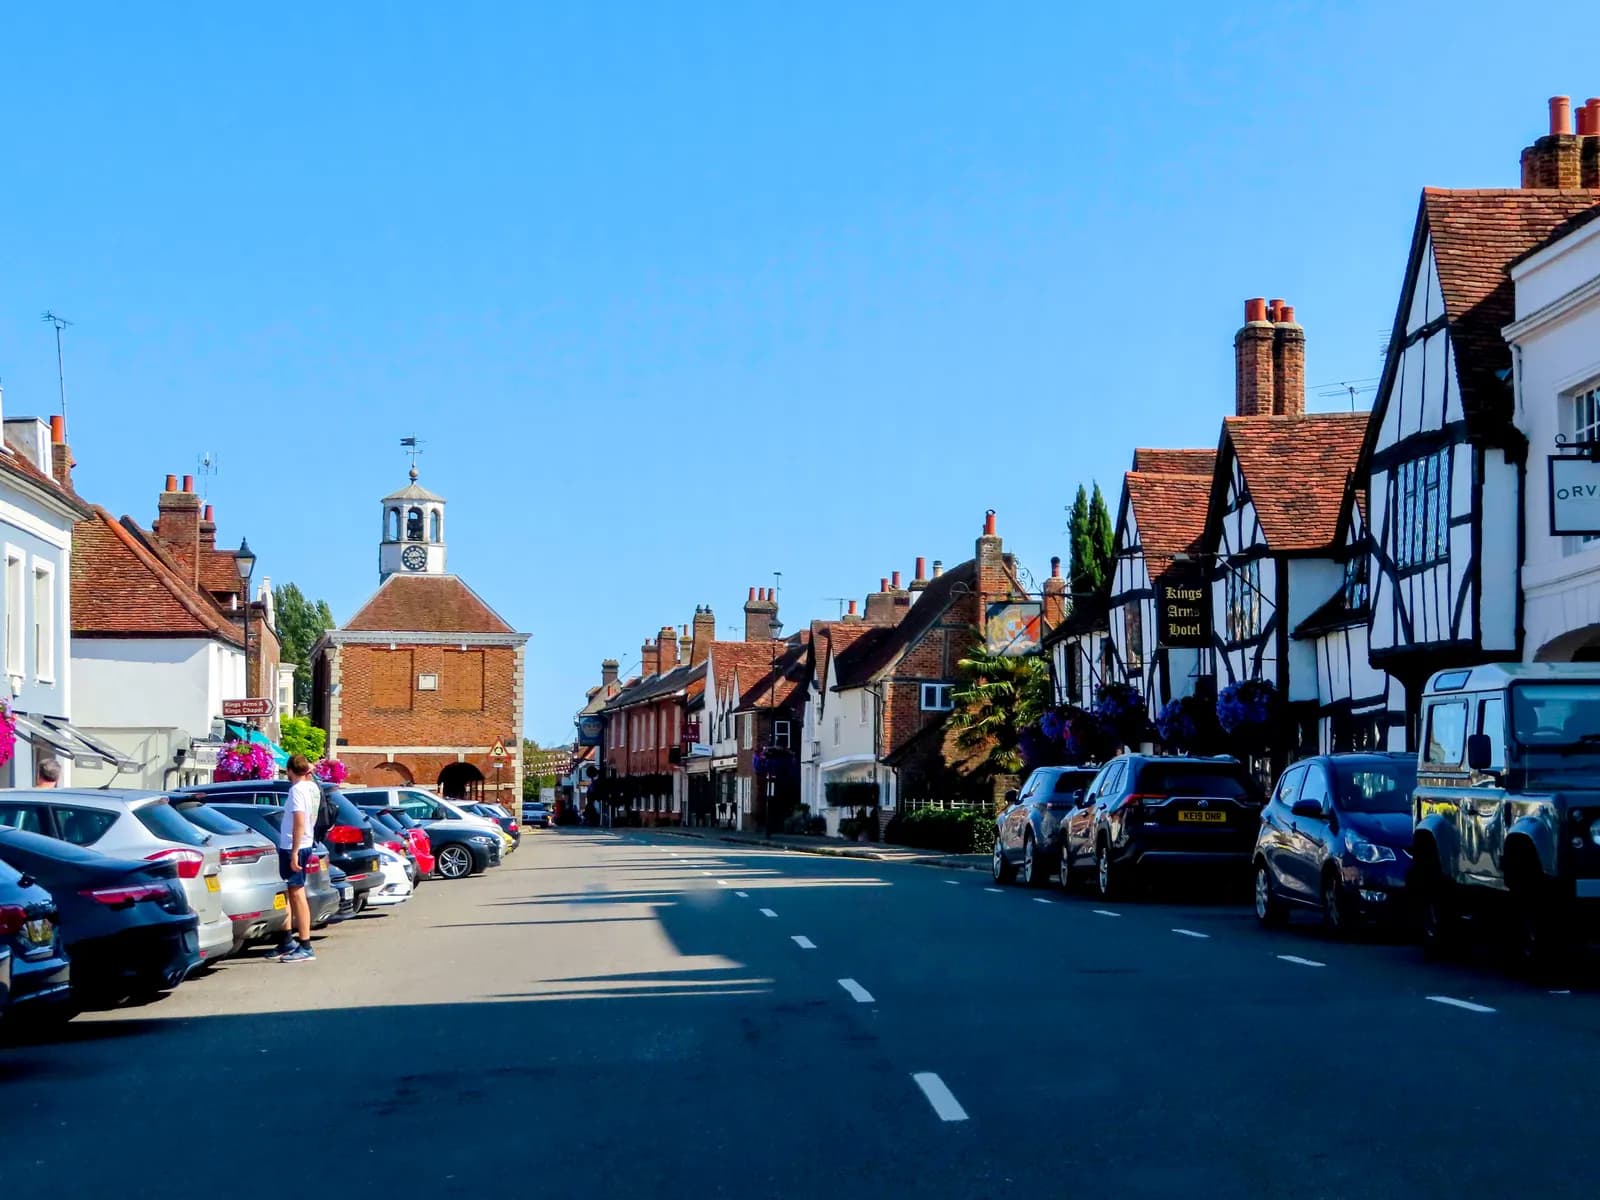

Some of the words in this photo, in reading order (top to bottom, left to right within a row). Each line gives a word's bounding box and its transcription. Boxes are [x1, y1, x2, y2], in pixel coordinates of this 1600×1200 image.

[1556, 484, 1600, 500] ORV
[1164, 583, 1203, 601] Kings
[1167, 604, 1200, 618] Arms
[1168, 623, 1201, 638] Hotel
